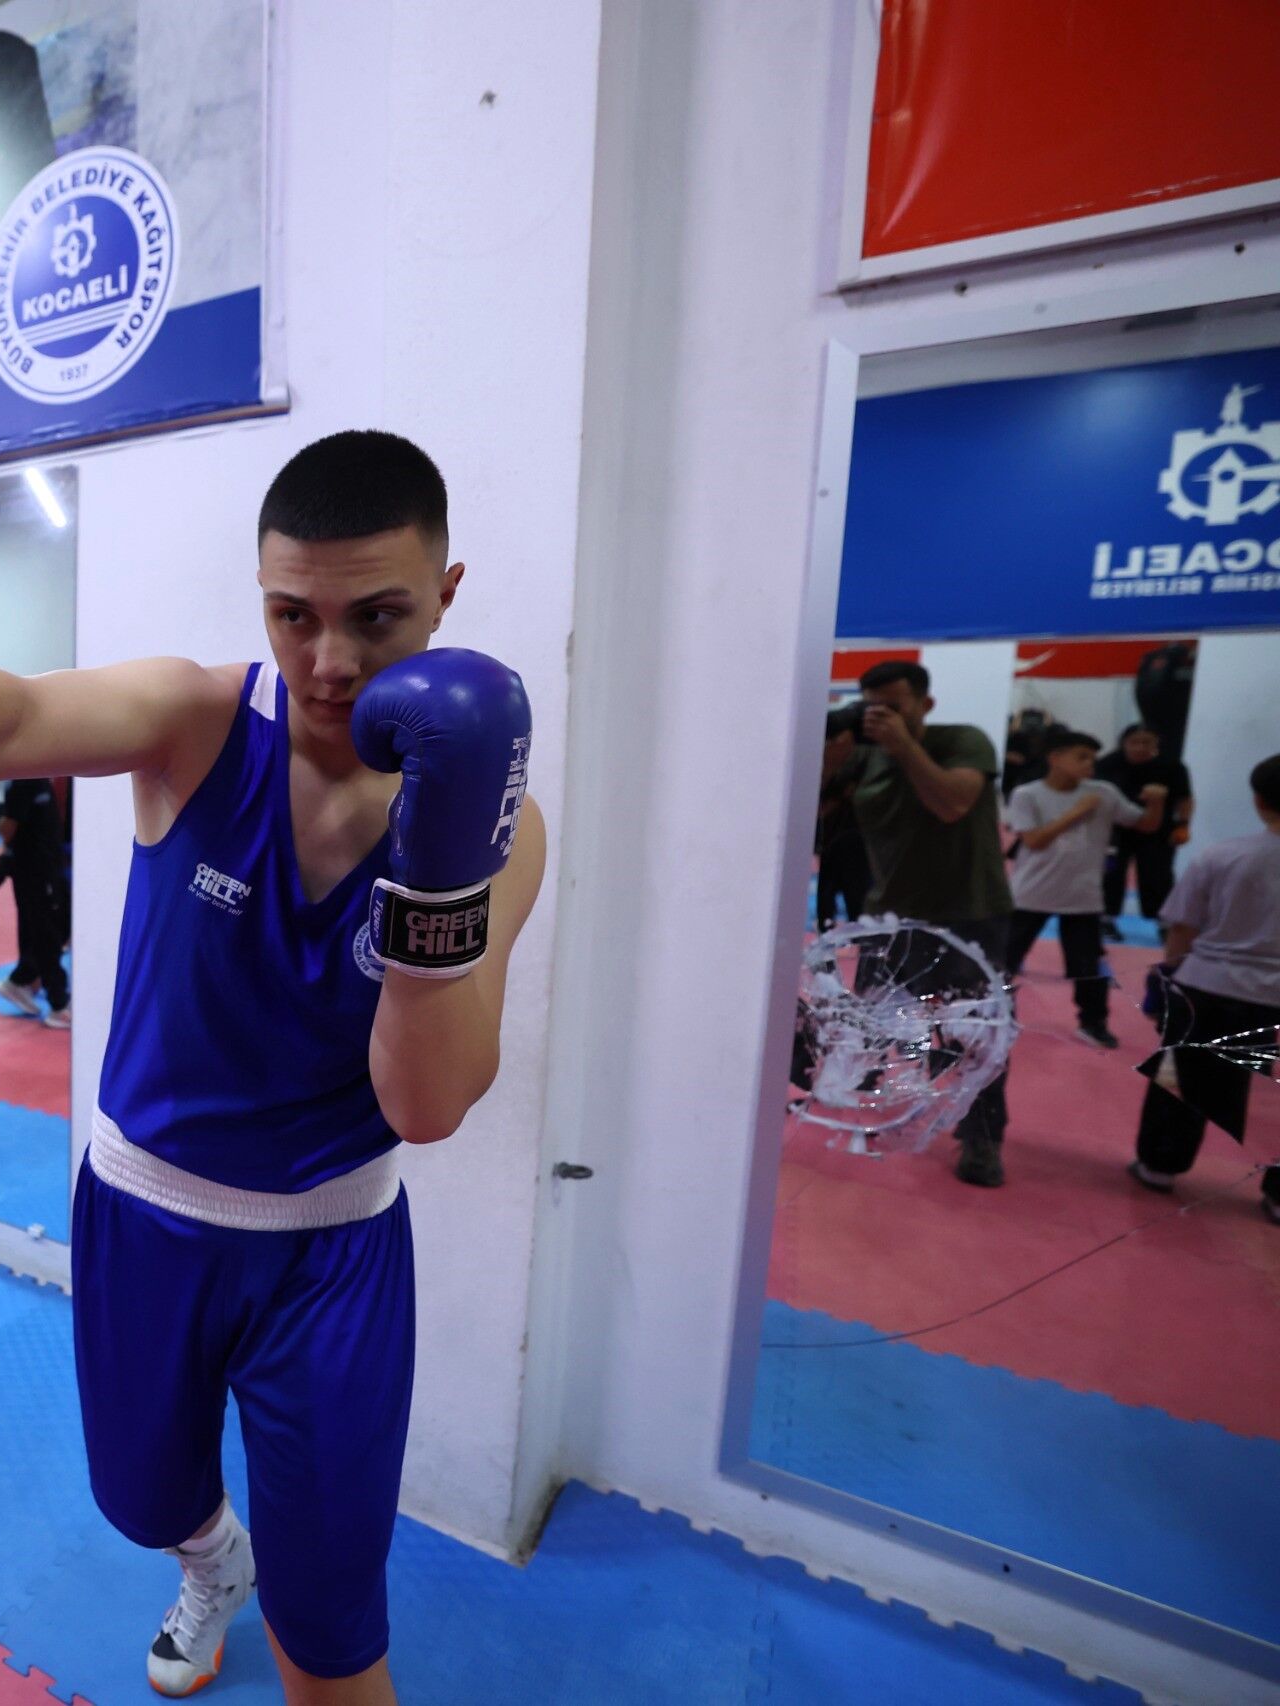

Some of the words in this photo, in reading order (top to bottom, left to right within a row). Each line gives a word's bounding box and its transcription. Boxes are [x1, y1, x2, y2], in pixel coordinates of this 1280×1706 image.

[30, 161, 134, 214] BELEDİYE
[116, 191, 166, 349] KAĞITSPOR
[22, 264, 129, 322] KOCAELİ
[59, 363, 89, 381] 1937
[193, 871, 236, 905] HILL
[196, 862, 252, 897] GREEN
[405, 901, 488, 932] GREEN
[407, 926, 481, 955] HILL
